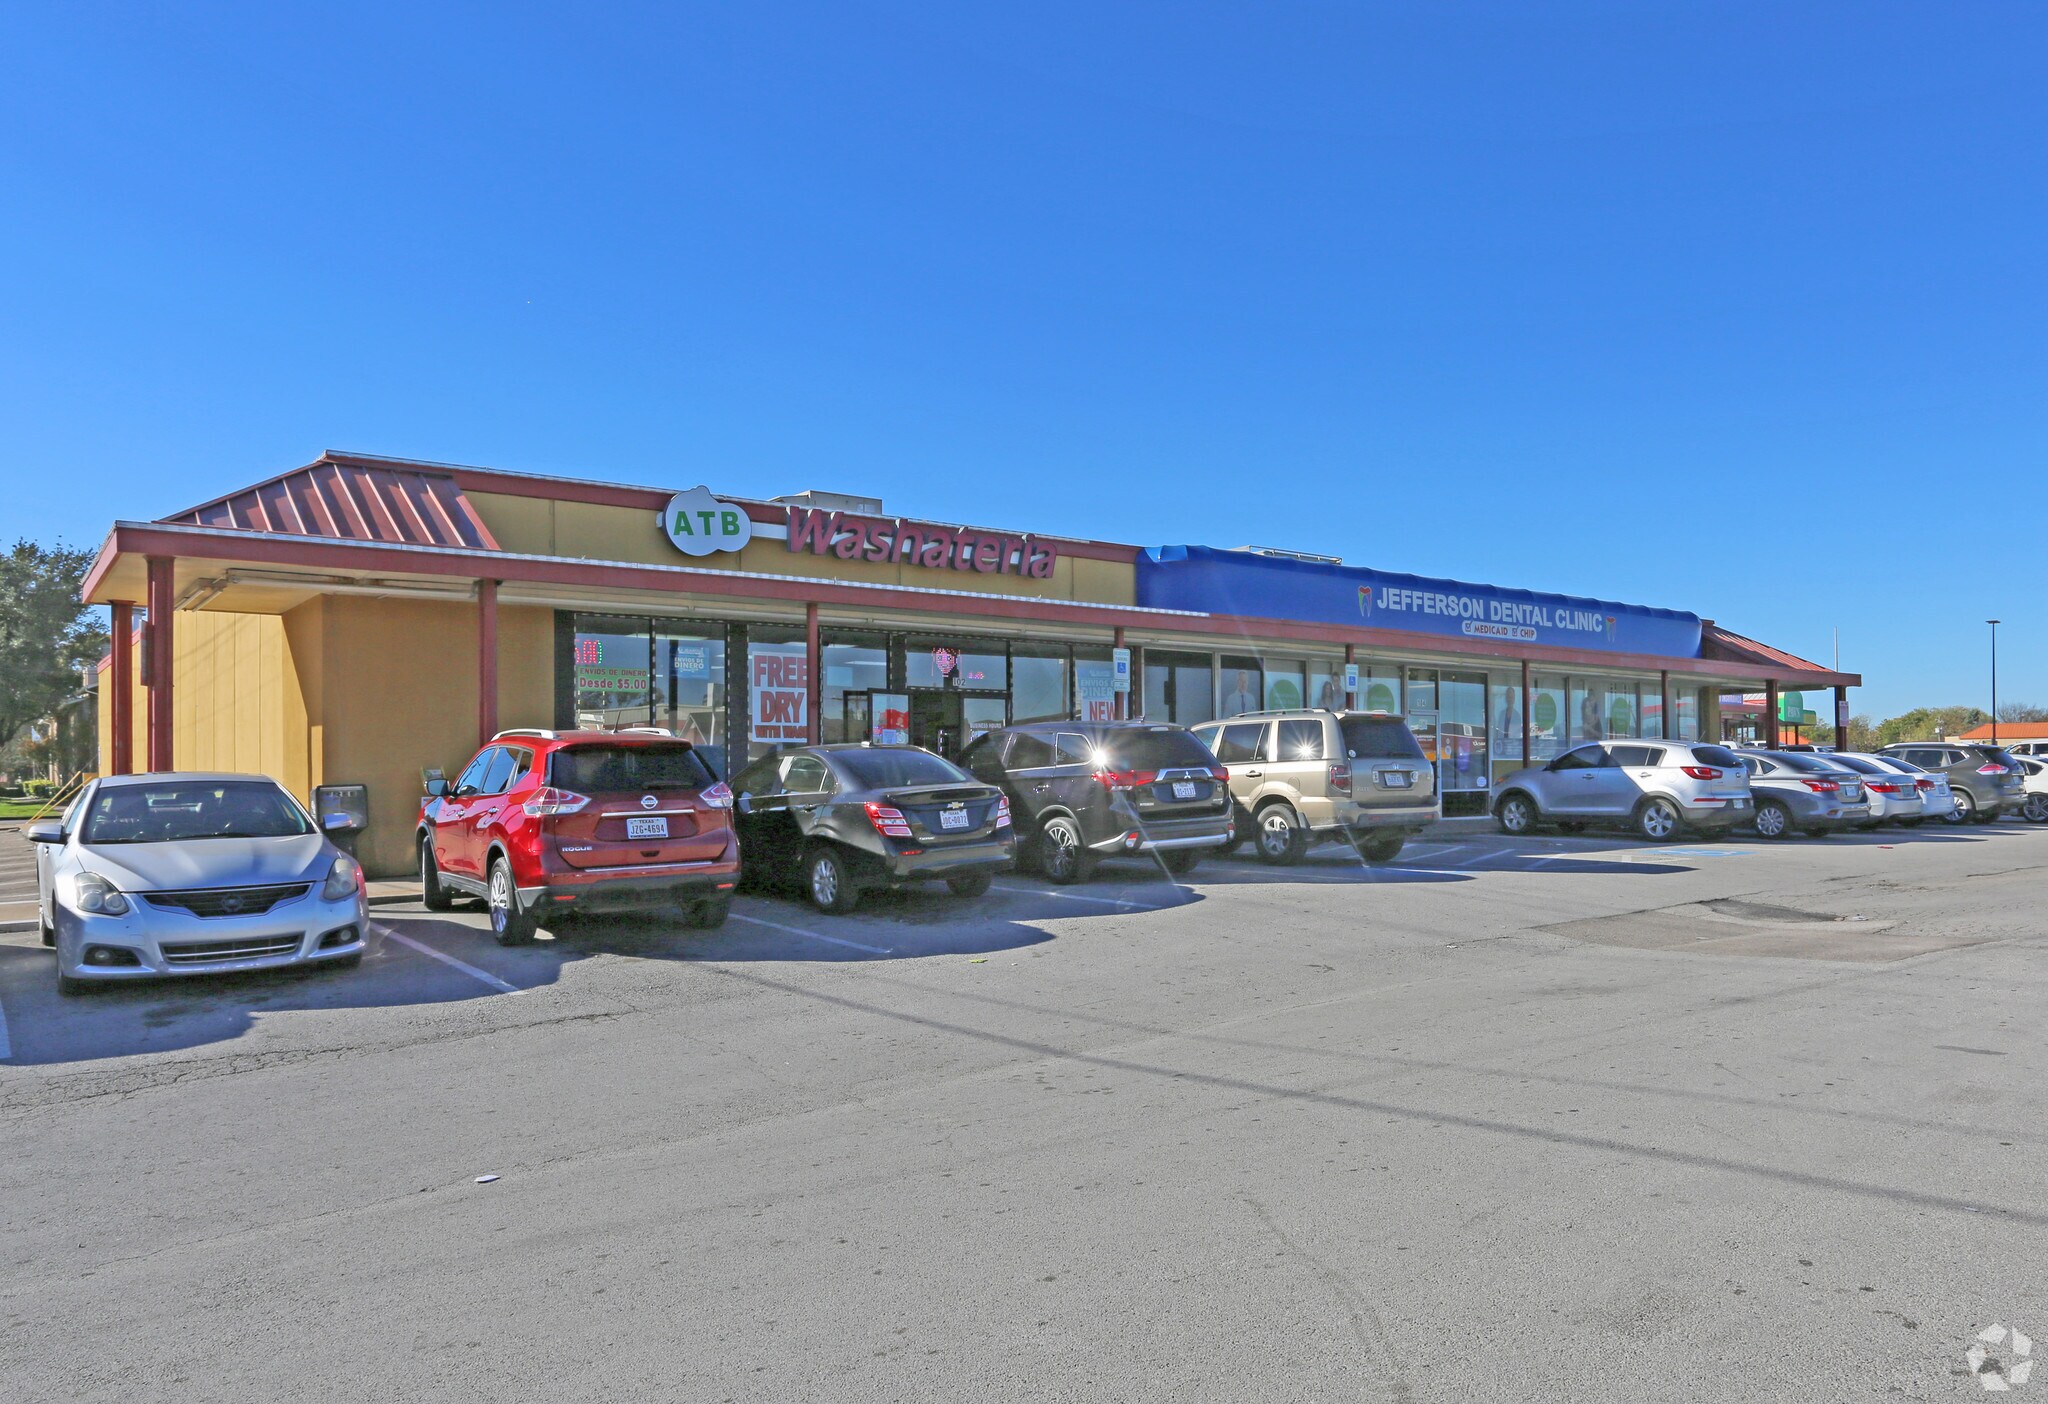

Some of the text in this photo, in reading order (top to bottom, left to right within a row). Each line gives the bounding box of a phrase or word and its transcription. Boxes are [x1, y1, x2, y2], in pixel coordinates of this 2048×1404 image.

[673, 506, 1058, 579] ATB Washateria
[1377, 587, 1603, 632] JEFFERSON DENTAL CLINIC
[1474, 624, 1535, 638] MEDICAID CHIP
[621, 669, 647, 677] DINERO
[754, 655, 807, 689] FREE
[579, 677, 647, 690] Desde $5.00
[1081, 686, 1115, 697] DINER
[760, 690, 805, 723] DRY
[754, 725, 807, 739] WITH WAS
